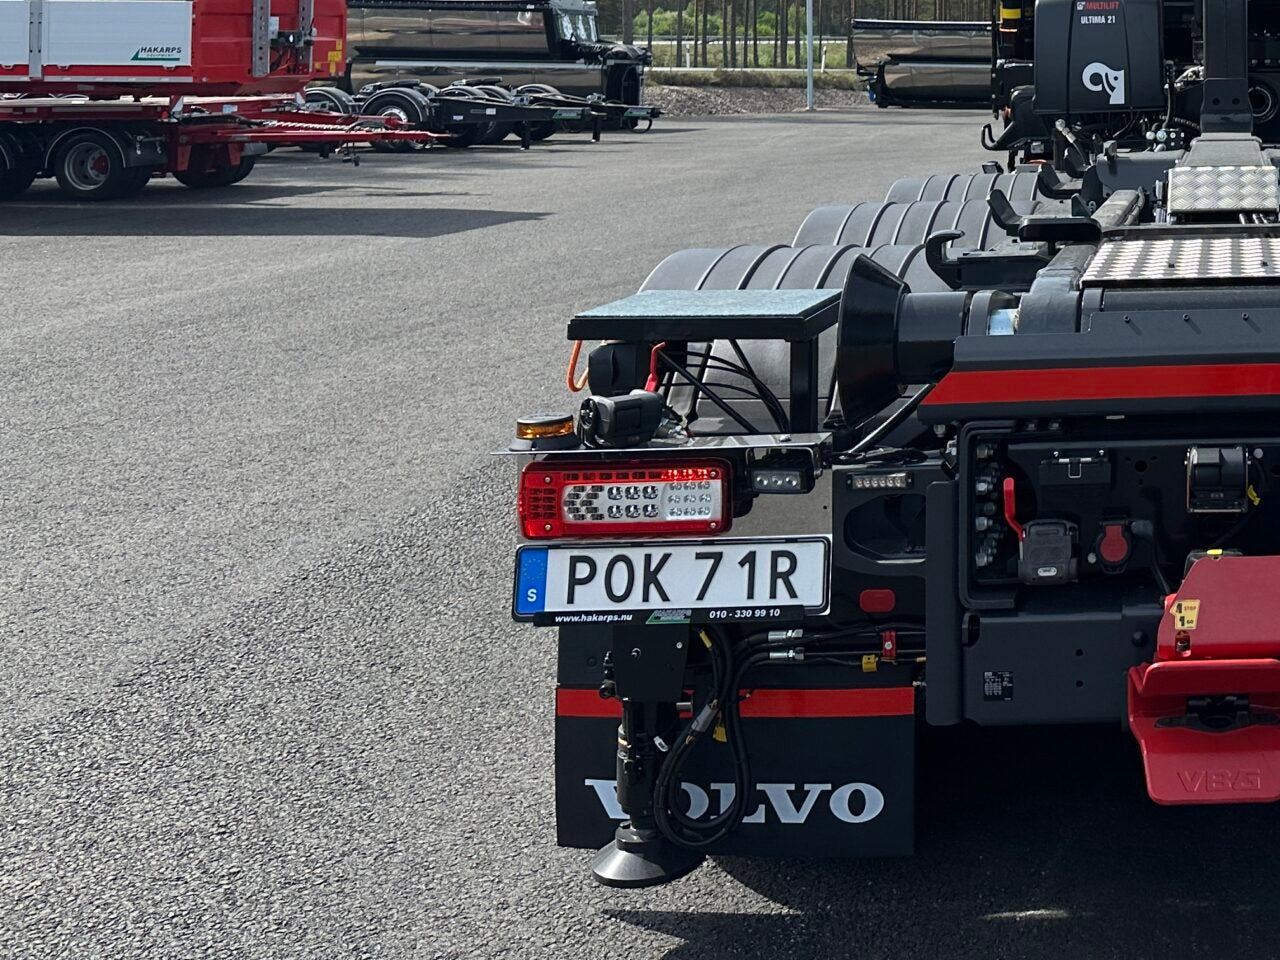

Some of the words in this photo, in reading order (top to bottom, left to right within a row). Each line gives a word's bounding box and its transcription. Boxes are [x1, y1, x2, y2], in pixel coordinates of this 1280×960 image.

[1080, 15, 1106, 24] ULTIMA
[1107, 15, 1116, 23] 21
[140, 46, 182, 54] HAKARPS
[527, 588, 537, 602] S
[566, 552, 673, 605] POK
[695, 549, 799, 602] 71R
[555, 613, 633, 623] www.hakarps.nu
[709, 610, 727, 619] 010
[734, 609, 753, 618] 330
[754, 609, 767, 617] 99
[769, 608, 781, 617] 10
[1175, 767, 1262, 793] VBG
